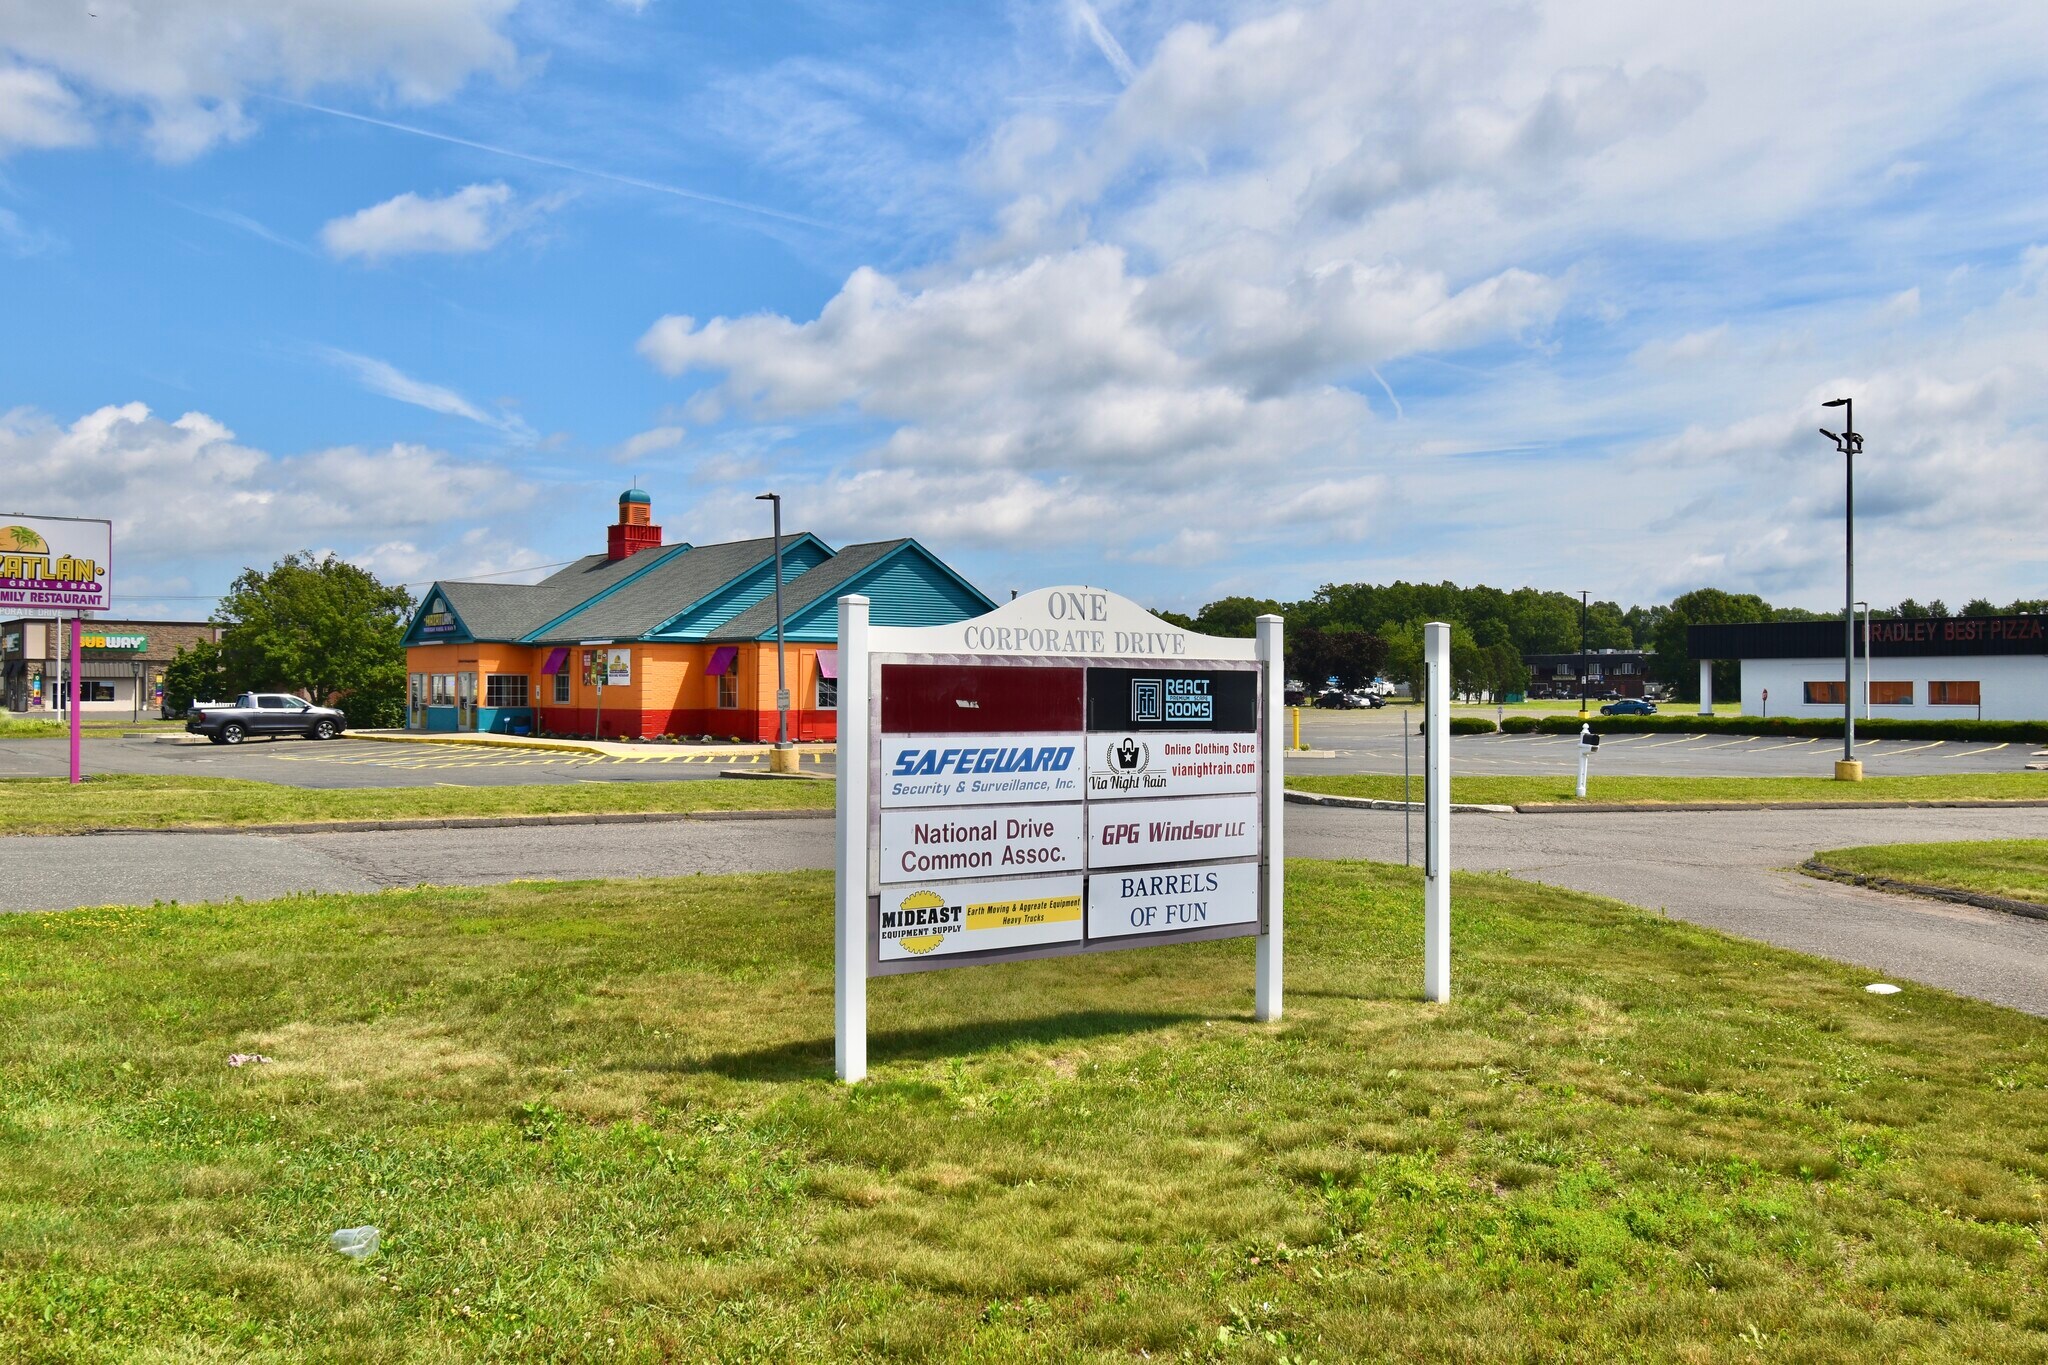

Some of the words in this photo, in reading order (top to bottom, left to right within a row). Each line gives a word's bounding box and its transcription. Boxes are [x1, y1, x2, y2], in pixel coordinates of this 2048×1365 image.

[9, 580, 48, 588] GRILL
[71, 582, 96, 590] BAR
[30, 592, 103, 605] RESTAURANT
[1048, 591, 1107, 621] ONE
[38, 608, 62, 616] DRIVE
[1944, 621, 1985, 641] BEST
[1991, 619, 2043, 640] PIZZA
[964, 626, 1104, 653] CORPORATE
[1115, 631, 1185, 654] DRIVE
[1167, 679, 1210, 694] REACT
[1167, 702, 1210, 716] ROOMS
[1164, 743, 1191, 756] Online
[1195, 741, 1229, 755] Clothing
[1233, 742, 1255, 754] Store
[892, 746, 1075, 776] SAFEGUARD
[1172, 761, 1255, 778] vianightrain.com
[892, 781, 951, 796] Security
[956, 780, 966, 792] &
[971, 778, 1050, 792] Surveillance,
[1055, 777, 1076, 790] Inc.
[1089, 776, 1107, 790] Via
[1109, 775, 1141, 792] Night
[1142, 774, 1167, 788] Rain
[914, 820, 997, 845] National
[1006, 818, 1055, 839] Drive
[1102, 823, 1140, 846] GPG
[1149, 820, 1222, 843] Windsor
[1224, 821, 1246, 837] LLC
[901, 850, 992, 873] Common
[1001, 845, 1066, 866] Assoc.
[1120, 872, 1218, 898] BARRELS
[967, 907, 985, 916] Earth
[987, 905, 1009, 915] Moving
[1012, 903, 1017, 912] &
[1019, 901, 1047, 913] Aggreate
[1049, 898, 1081, 910] Equipment
[1130, 906, 1158, 927] OF
[1165, 902, 1208, 924] FUN
[882, 905, 962, 928] MIDEAST
[1002, 916, 1021, 925] Heavy
[1024, 913, 1044, 923] Trucks
[881, 927, 929, 939] EQUIPMENT
[932, 924, 962, 936] SUPPLY
